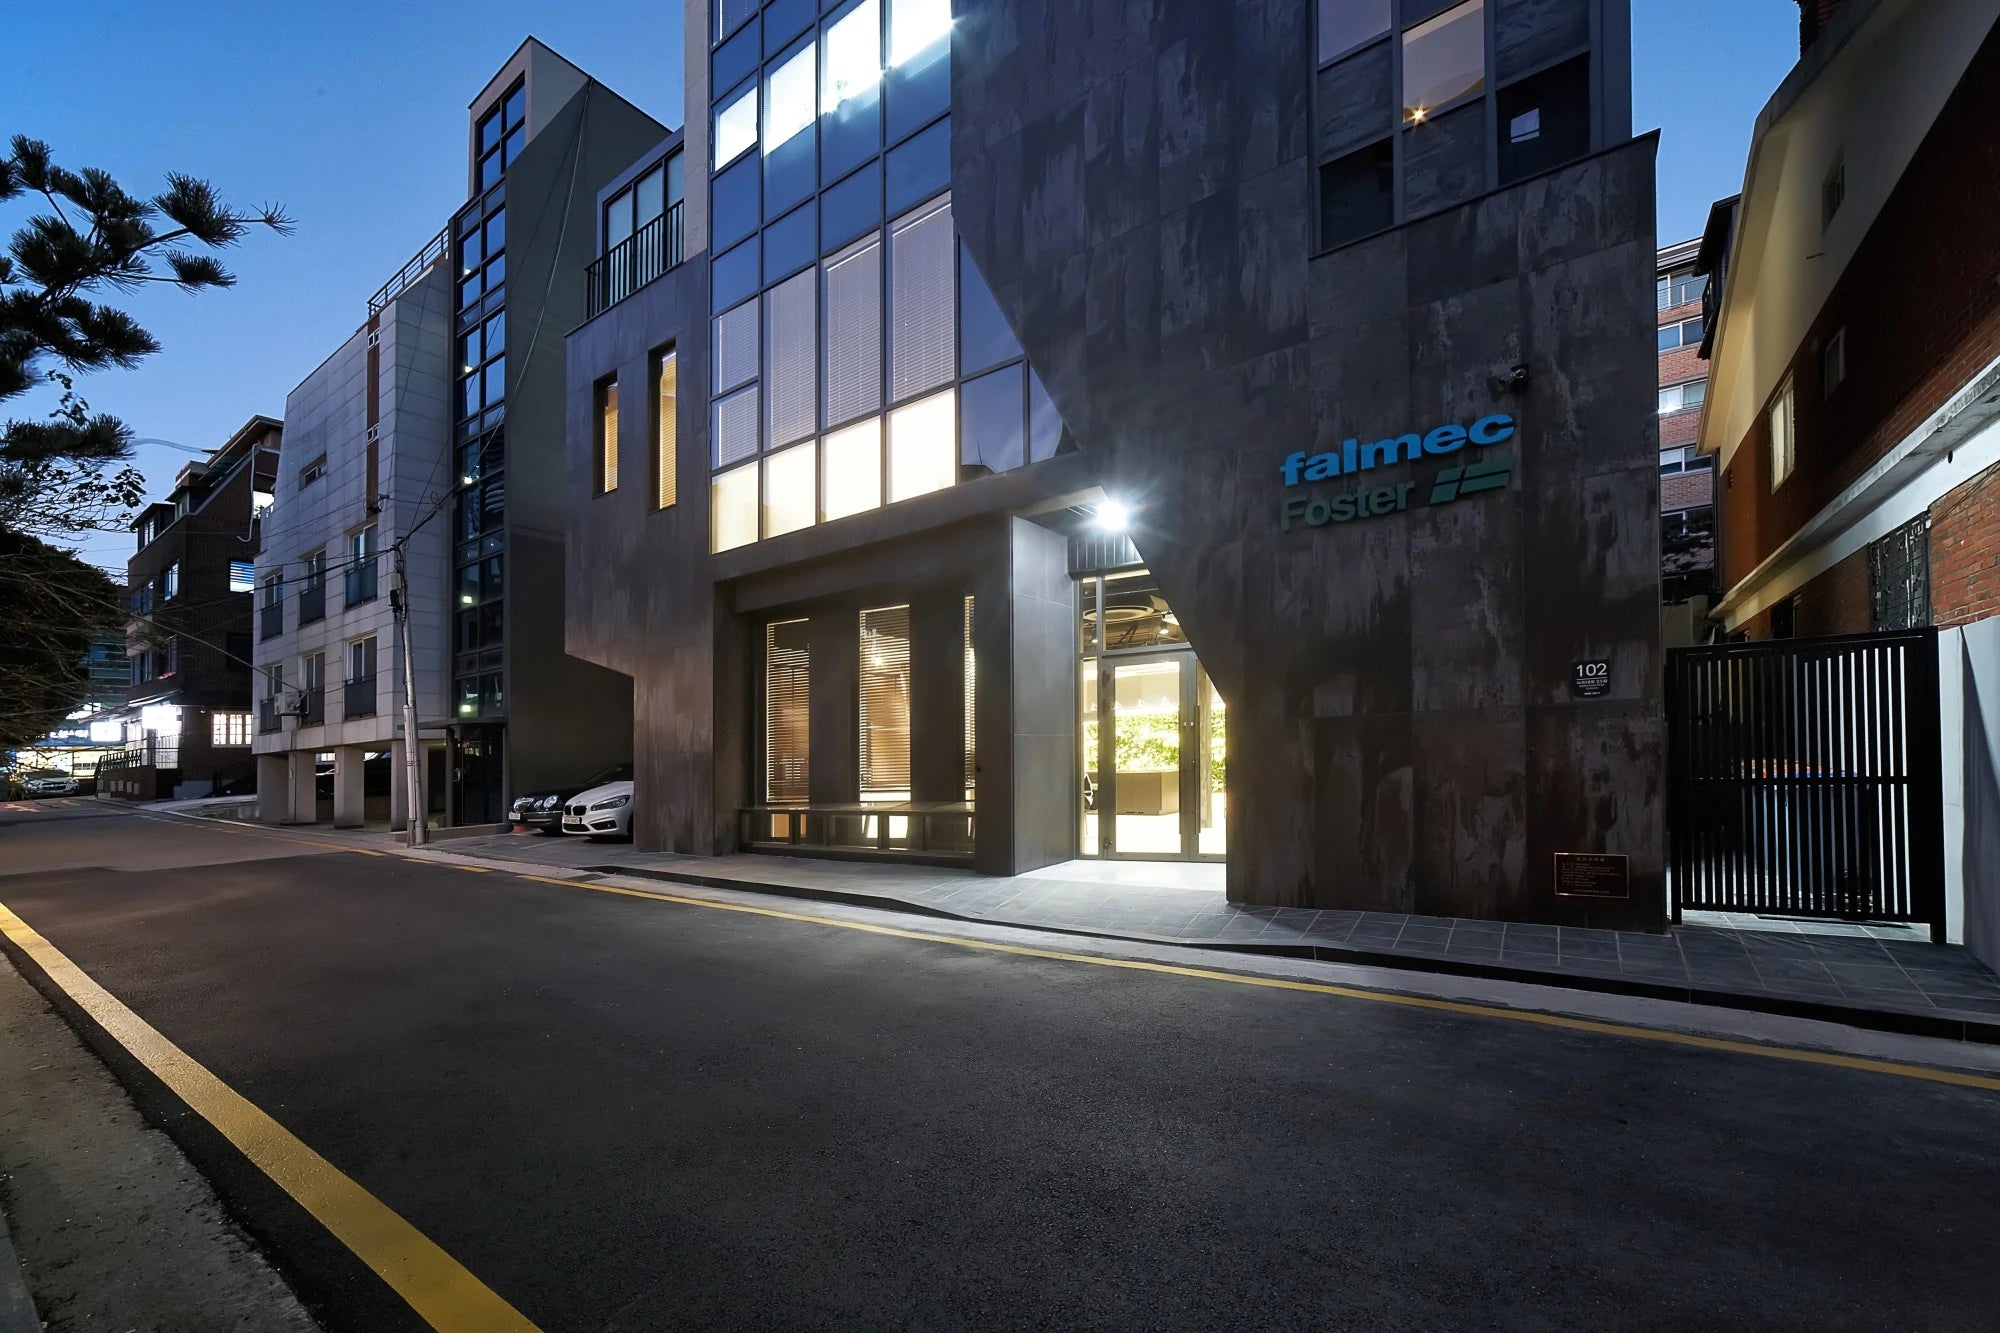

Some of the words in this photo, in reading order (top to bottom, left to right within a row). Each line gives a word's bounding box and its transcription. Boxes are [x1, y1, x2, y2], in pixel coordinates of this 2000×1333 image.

[1280, 413, 1515, 487] falmec
[1280, 480, 1416, 532] Foster
[1576, 662, 1608, 677] 102
